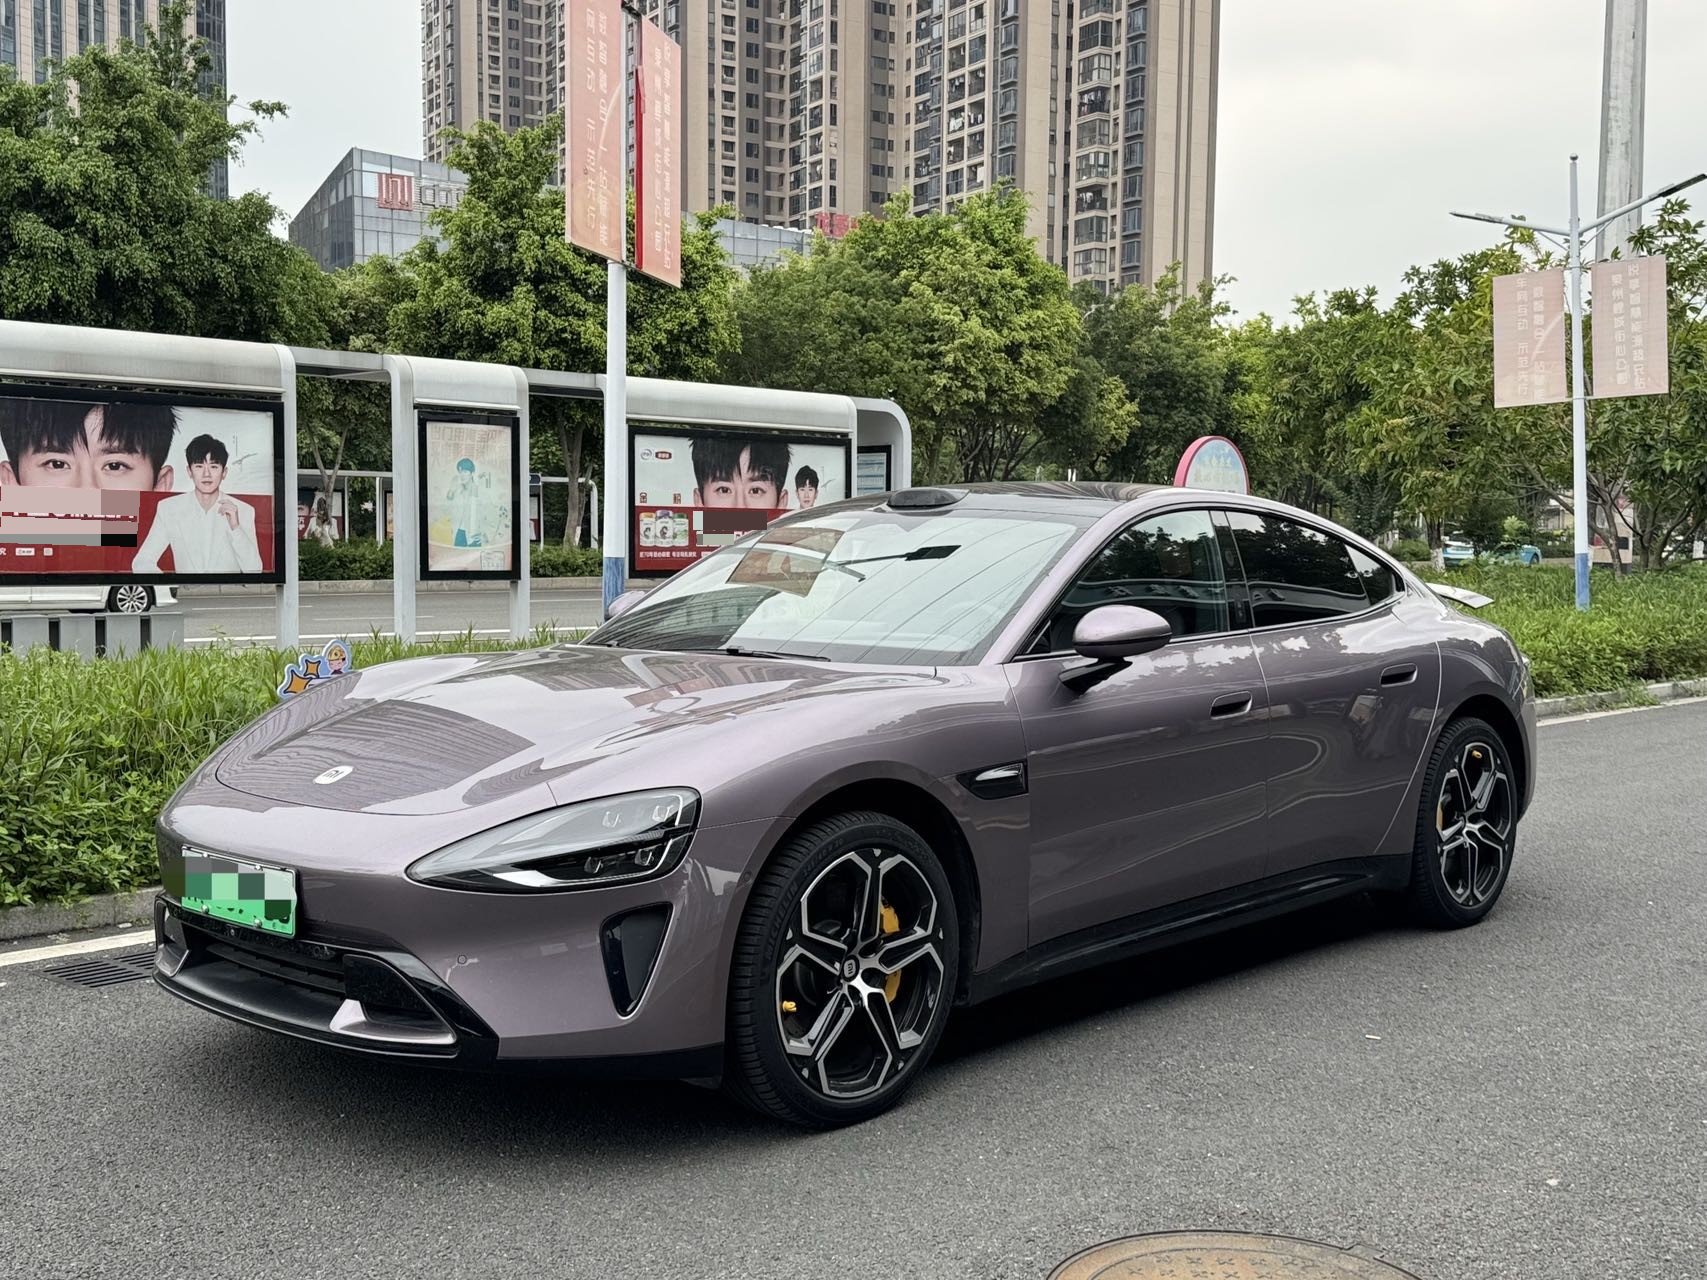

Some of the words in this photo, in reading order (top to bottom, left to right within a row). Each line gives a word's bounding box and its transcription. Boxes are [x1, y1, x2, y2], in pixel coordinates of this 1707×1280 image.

[1516, 278, 1528, 330] 车网互动
[766, 879, 799, 960] MICHELIN
